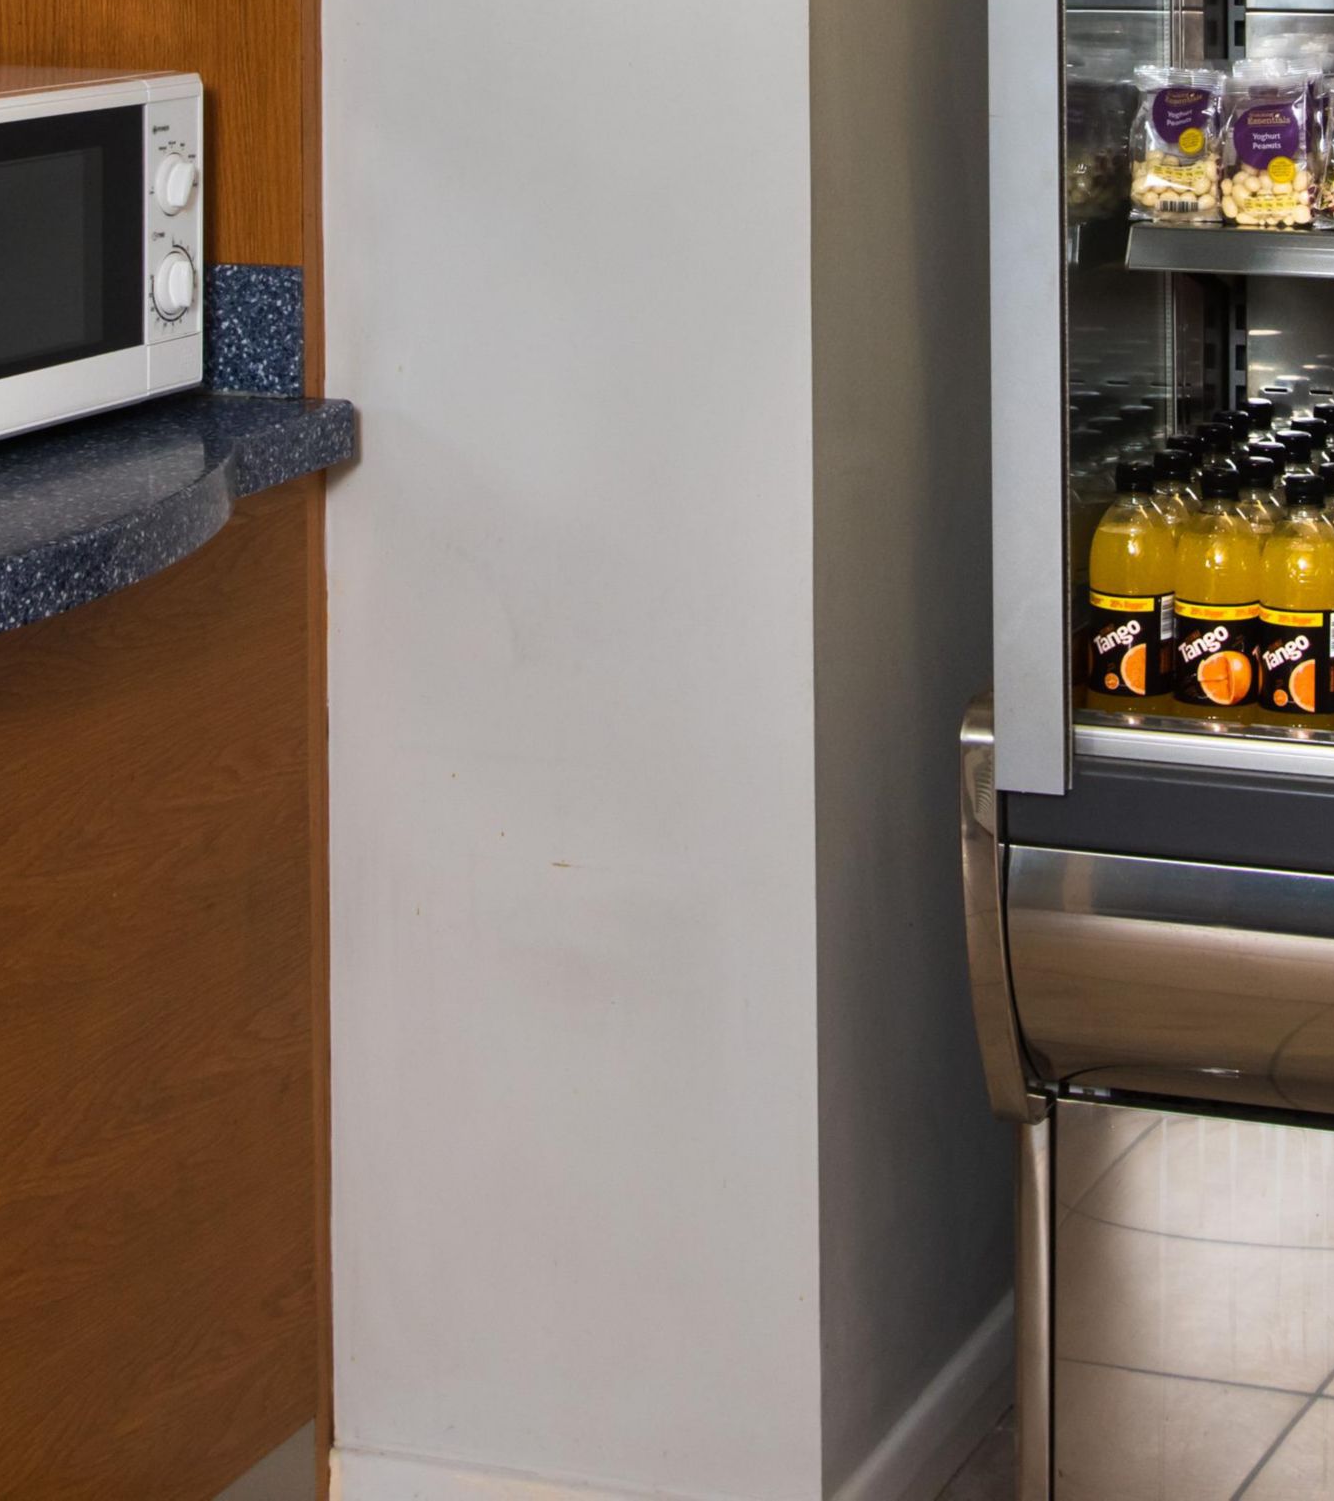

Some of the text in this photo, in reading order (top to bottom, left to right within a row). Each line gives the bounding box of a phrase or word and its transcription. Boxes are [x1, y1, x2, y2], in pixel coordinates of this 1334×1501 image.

[1252, 133, 1281, 142] Yoghurt
[1253, 142, 1282, 150] Peanuts
[1093, 620, 1142, 655] Tango
[1178, 625, 1229, 663] Tango
[1262, 635, 1311, 672] Tango
